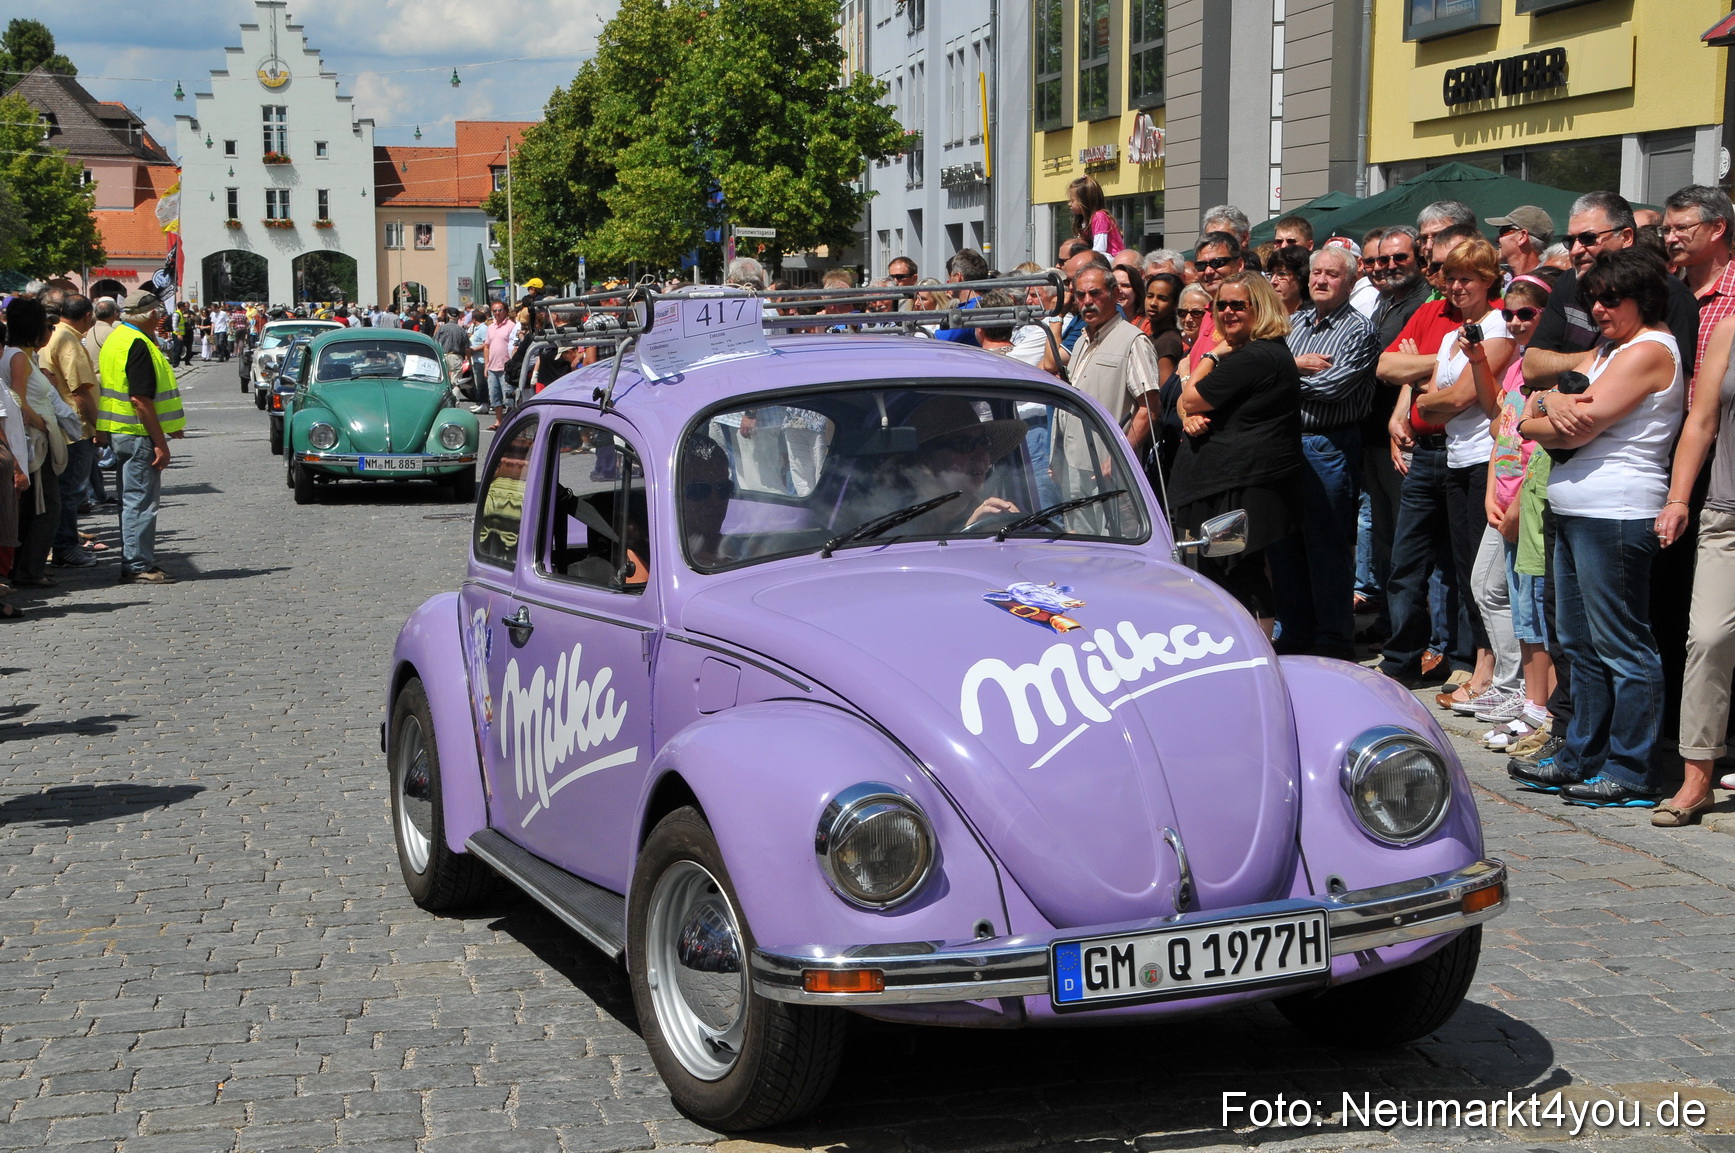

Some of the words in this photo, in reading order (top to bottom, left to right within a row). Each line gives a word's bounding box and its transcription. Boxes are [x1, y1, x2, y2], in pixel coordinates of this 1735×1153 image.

[1443, 60, 1500, 107] GERRY
[1500, 47, 1567, 97] WEBER
[737, 228, 774, 236] Brunnwirtsgasse
[696, 299, 746, 327] 417
[421, 362, 438, 370] 487
[365, 459, 378, 469] NM
[384, 459, 396, 469] ML
[398, 459, 416, 469] 885
[961, 621, 1235, 744] Milka
[500, 642, 628, 809] Milka
[1084, 943, 1136, 991] GM
[1167, 937, 1192, 981] Q
[1202, 919, 1322, 979] 1977H
[1064, 978, 1075, 991] D
